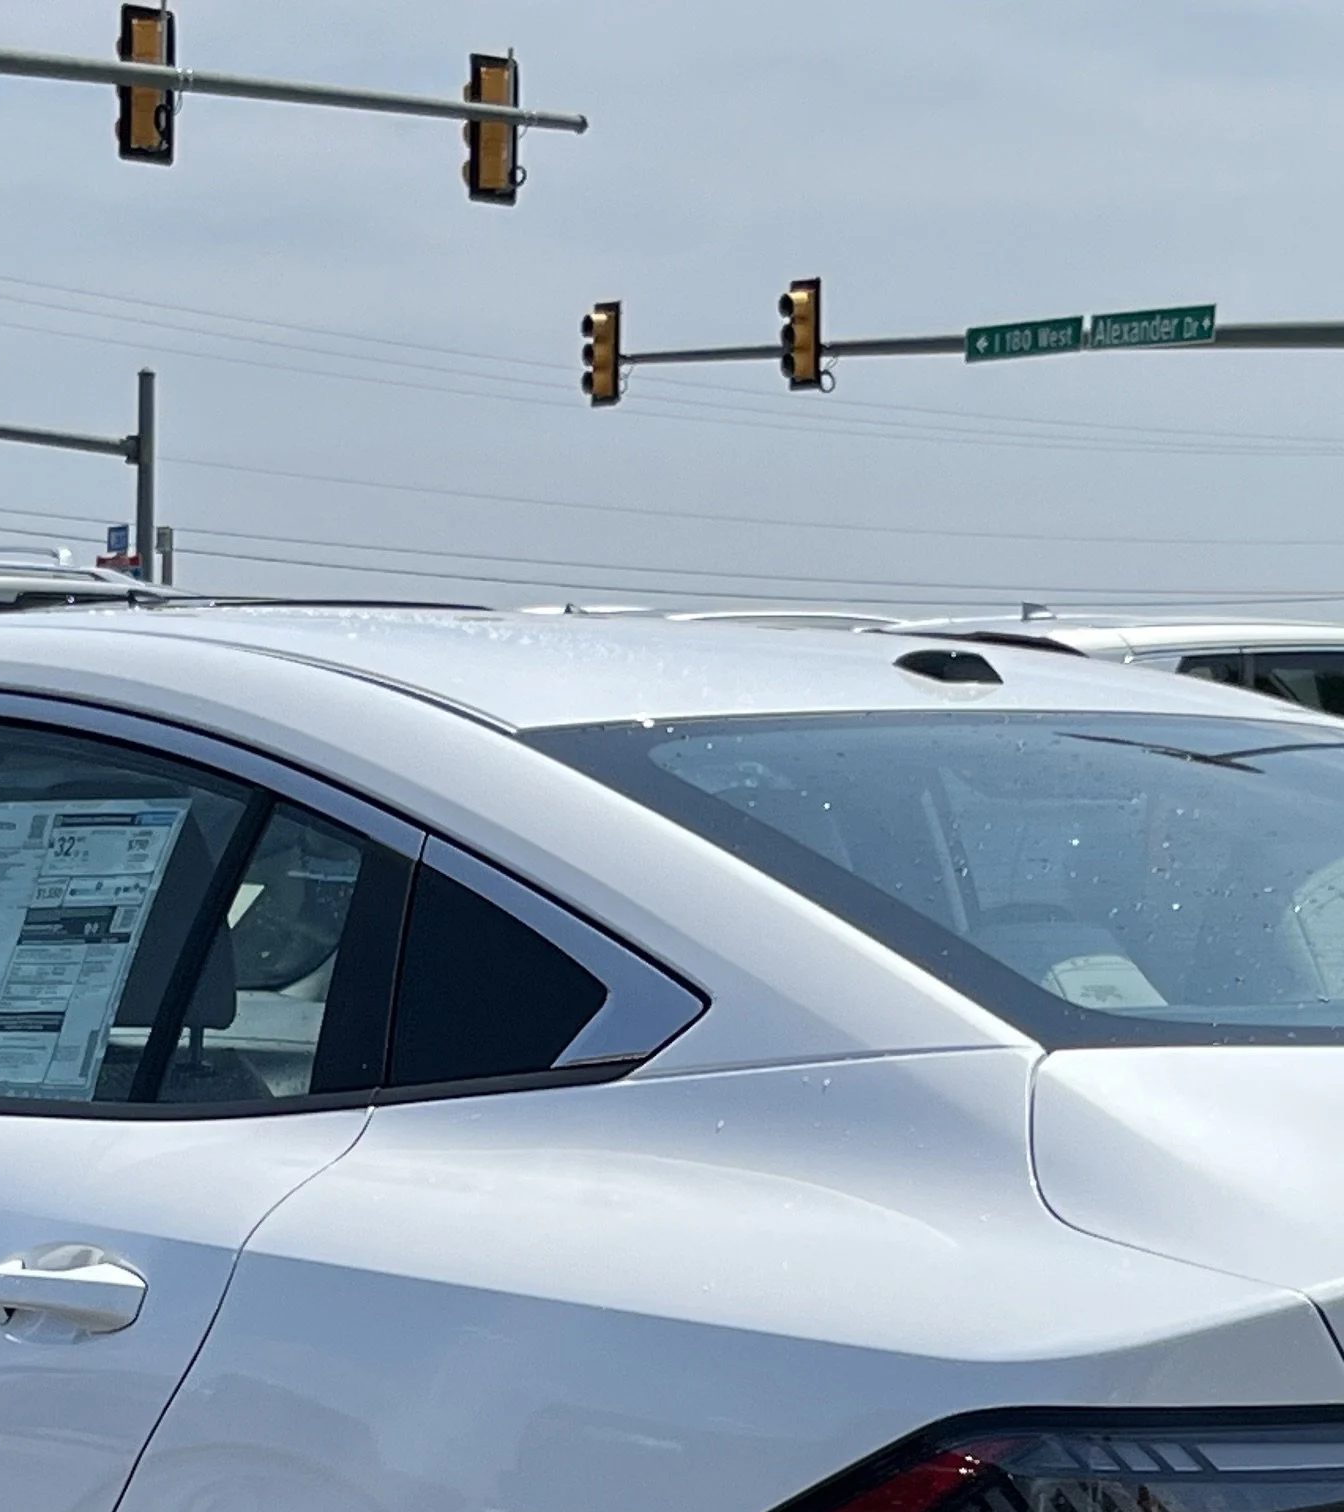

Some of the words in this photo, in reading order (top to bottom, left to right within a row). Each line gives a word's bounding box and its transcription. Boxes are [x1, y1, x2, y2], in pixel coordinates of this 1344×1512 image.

[1005, 329, 1032, 352] 180
[1037, 326, 1073, 348] West
[1093, 315, 1180, 344] Alexander
[1183, 316, 1199, 339] Dr
[54, 836, 76, 857] 32
